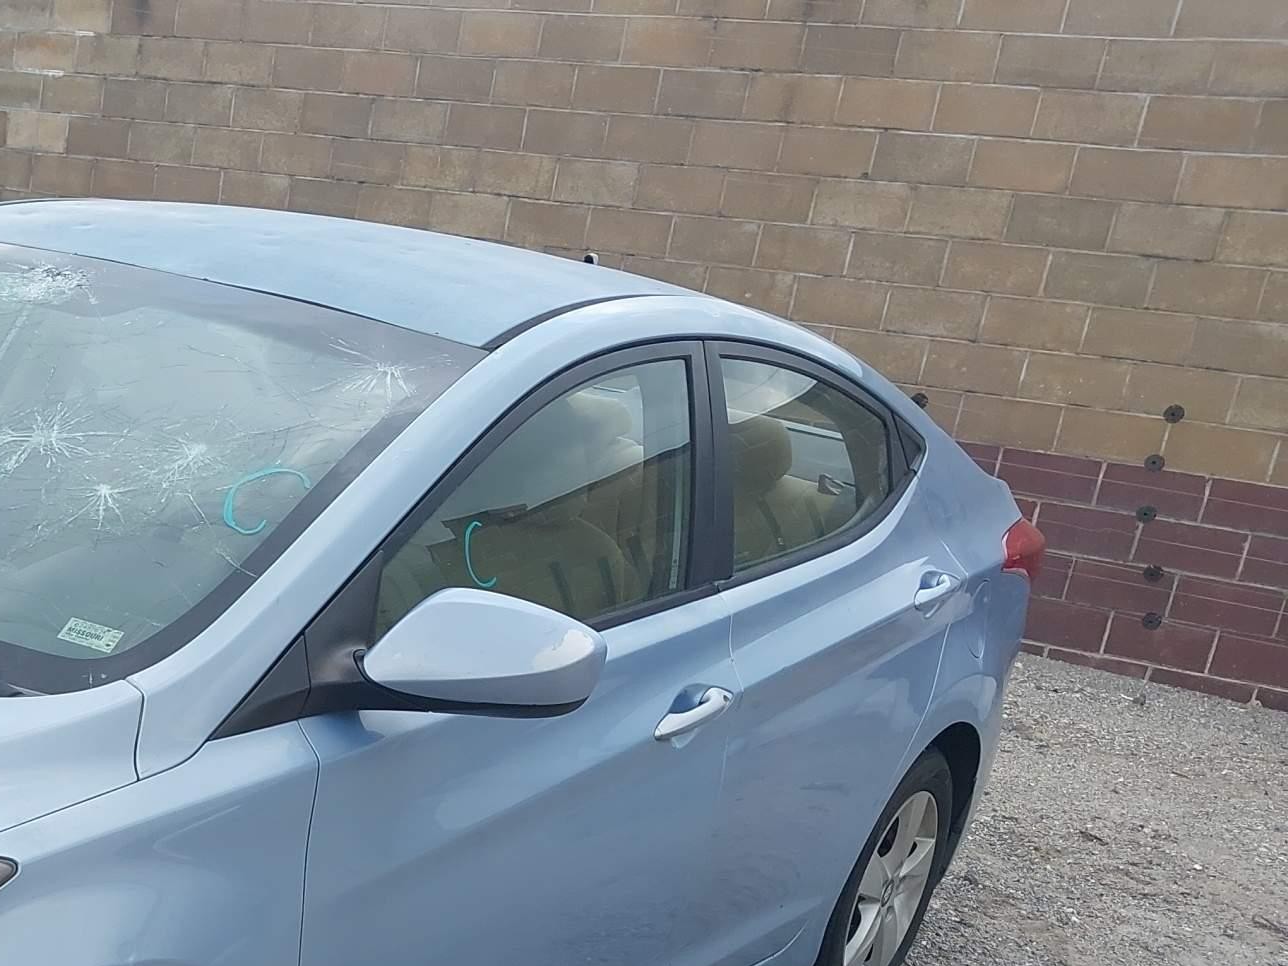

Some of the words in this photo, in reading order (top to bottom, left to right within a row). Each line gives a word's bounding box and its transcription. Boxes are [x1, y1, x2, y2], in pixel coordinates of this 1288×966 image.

[223, 468, 312, 535] C
[464, 521, 497, 588] C
[67, 626, 104, 641] MISSOURI
